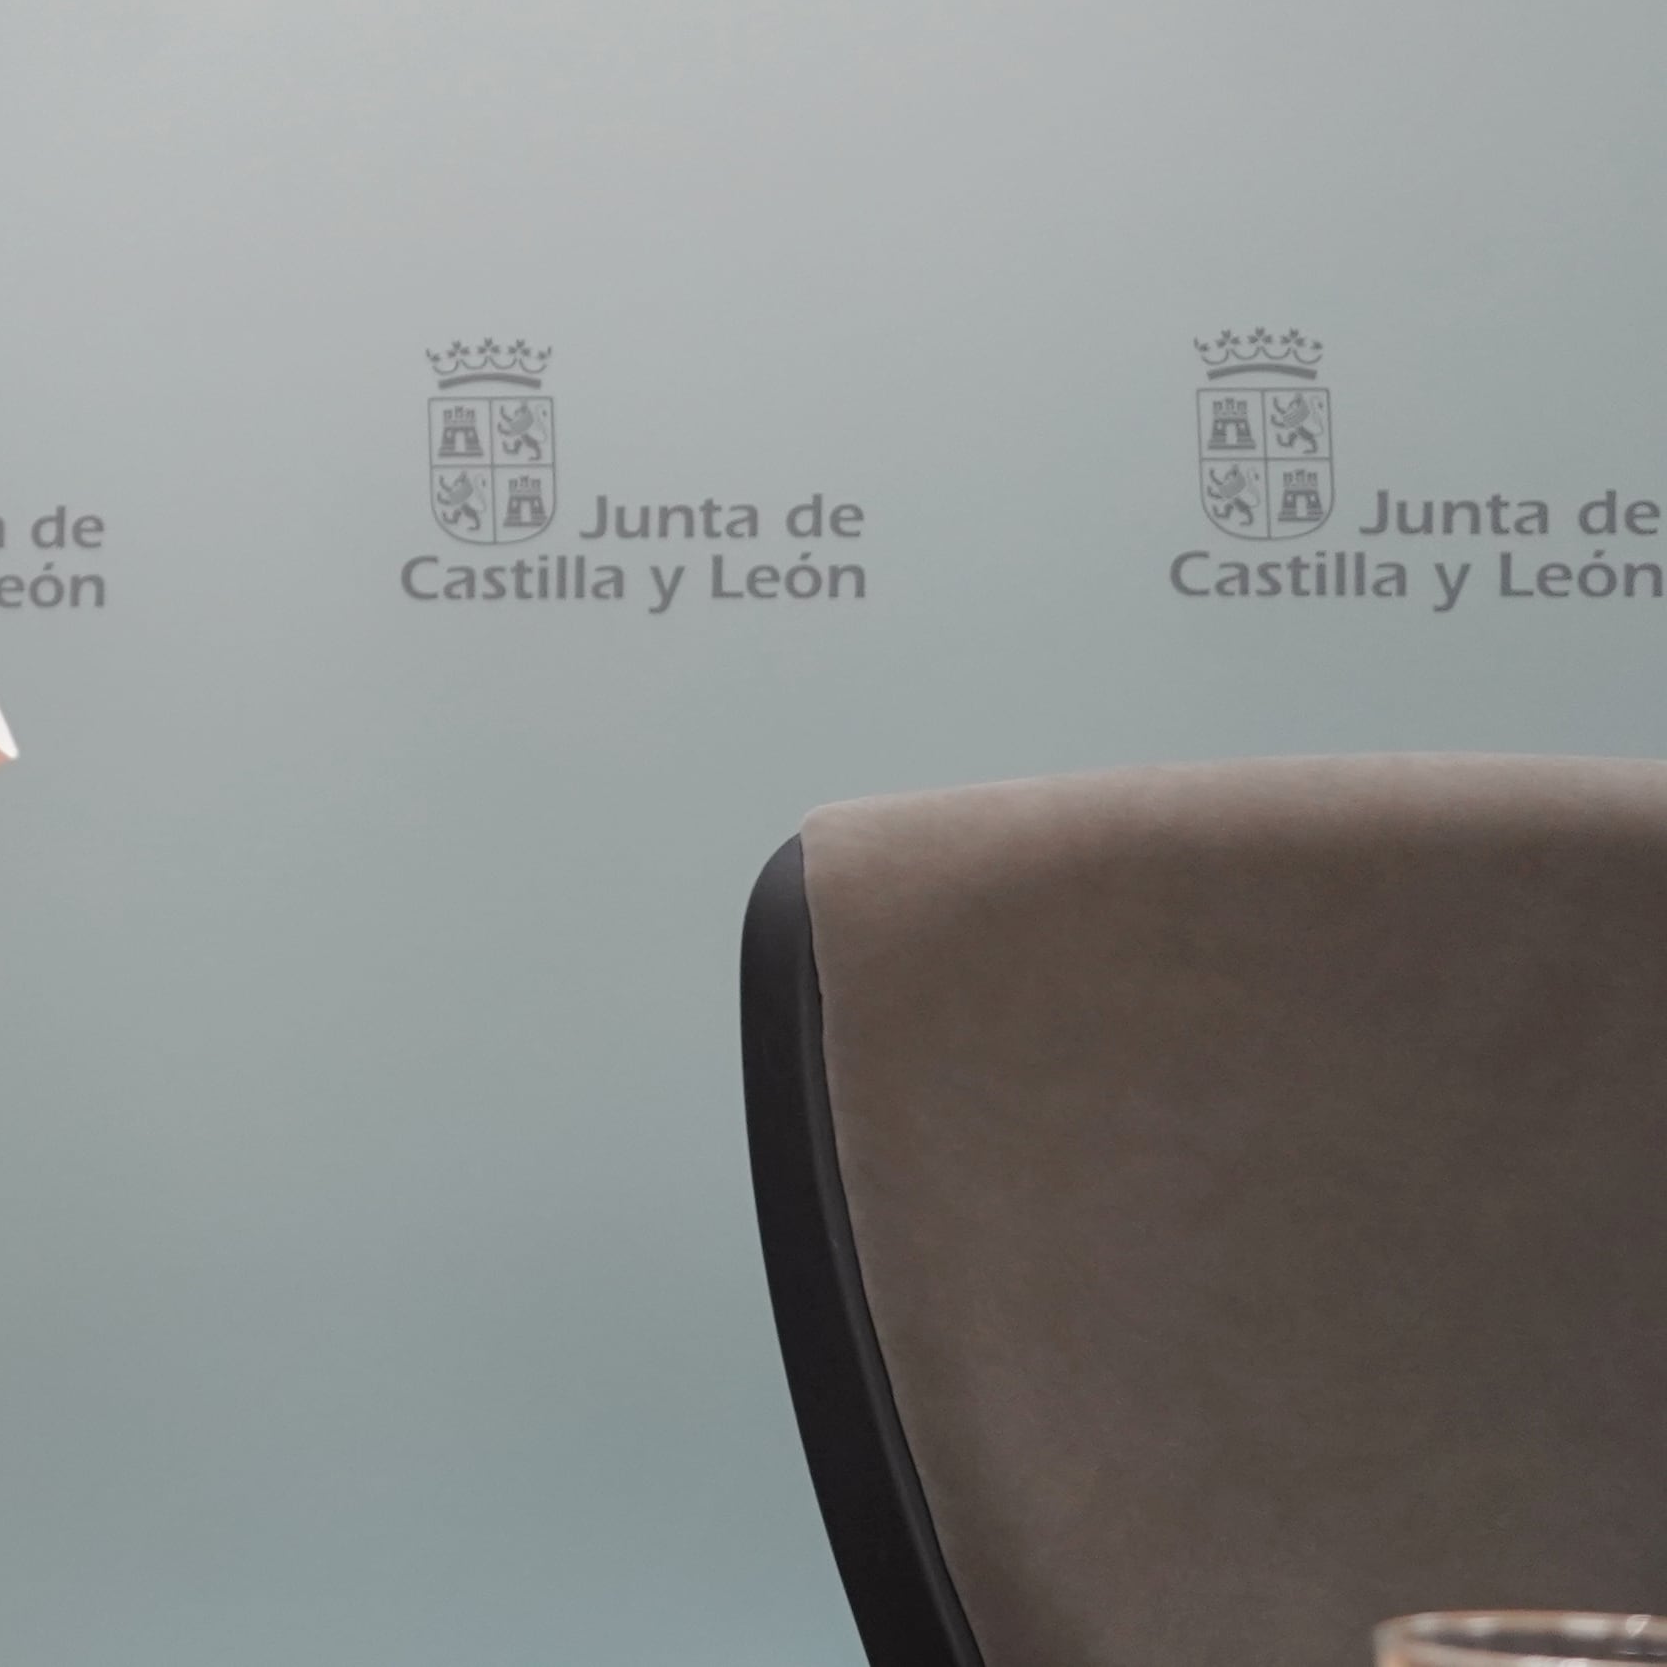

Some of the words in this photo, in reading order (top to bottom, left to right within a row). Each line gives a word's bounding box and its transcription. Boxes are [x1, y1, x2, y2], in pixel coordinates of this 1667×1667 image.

[30, 505, 105, 550] de
[579, 495, 759, 540] Junta
[785, 493, 865, 539] de
[1358, 489, 1549, 536] Junta
[1577, 489, 1663, 537] de
[400, 554, 625, 601] Castilla
[648, 565, 686, 615] y
[711, 550, 866, 600] León
[1170, 550, 1407, 599] Castilla
[1432, 562, 1472, 614] y
[1499, 548, 1666, 599] León
